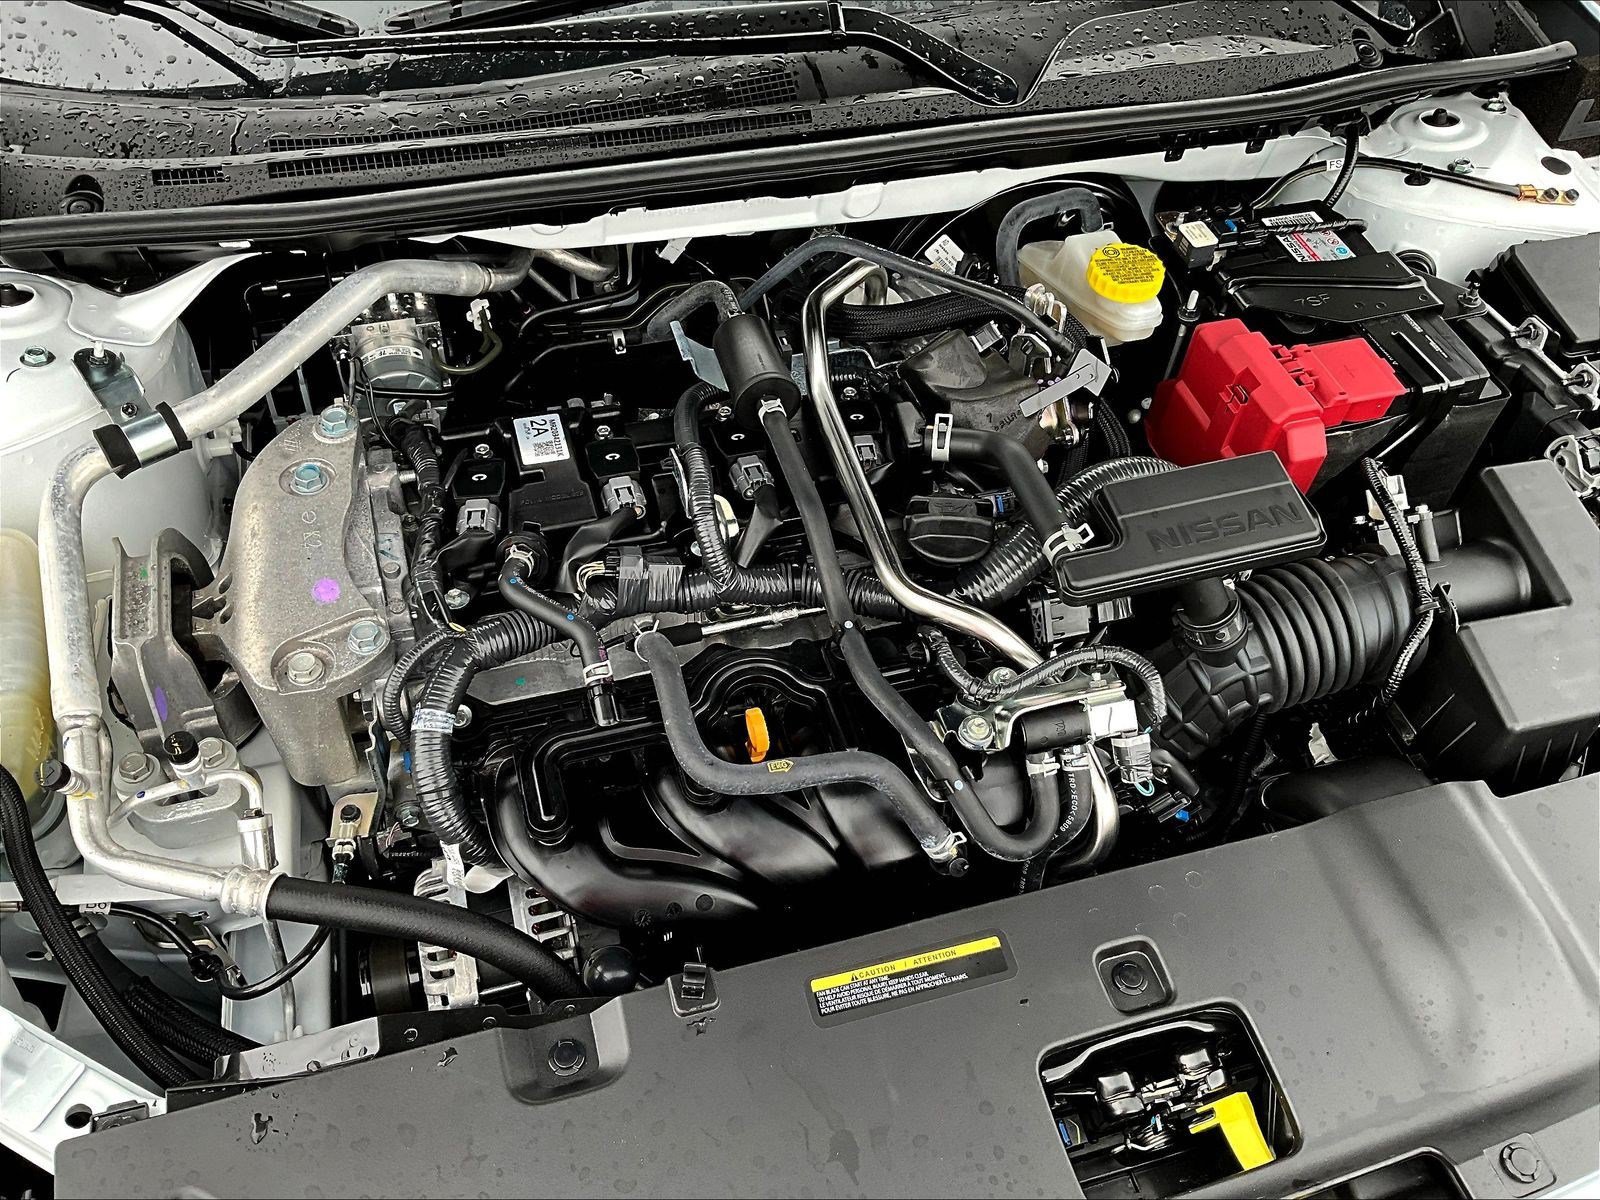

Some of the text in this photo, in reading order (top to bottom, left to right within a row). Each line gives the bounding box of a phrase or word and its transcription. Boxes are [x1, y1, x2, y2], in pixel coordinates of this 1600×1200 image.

[1329, 159, 1344, 169] FS
[530, 418, 550, 438] 2A
[1145, 501, 1304, 552] NISSAN
[858, 964, 896, 979] CAUTION
[913, 949, 957, 965] ATTENTION
